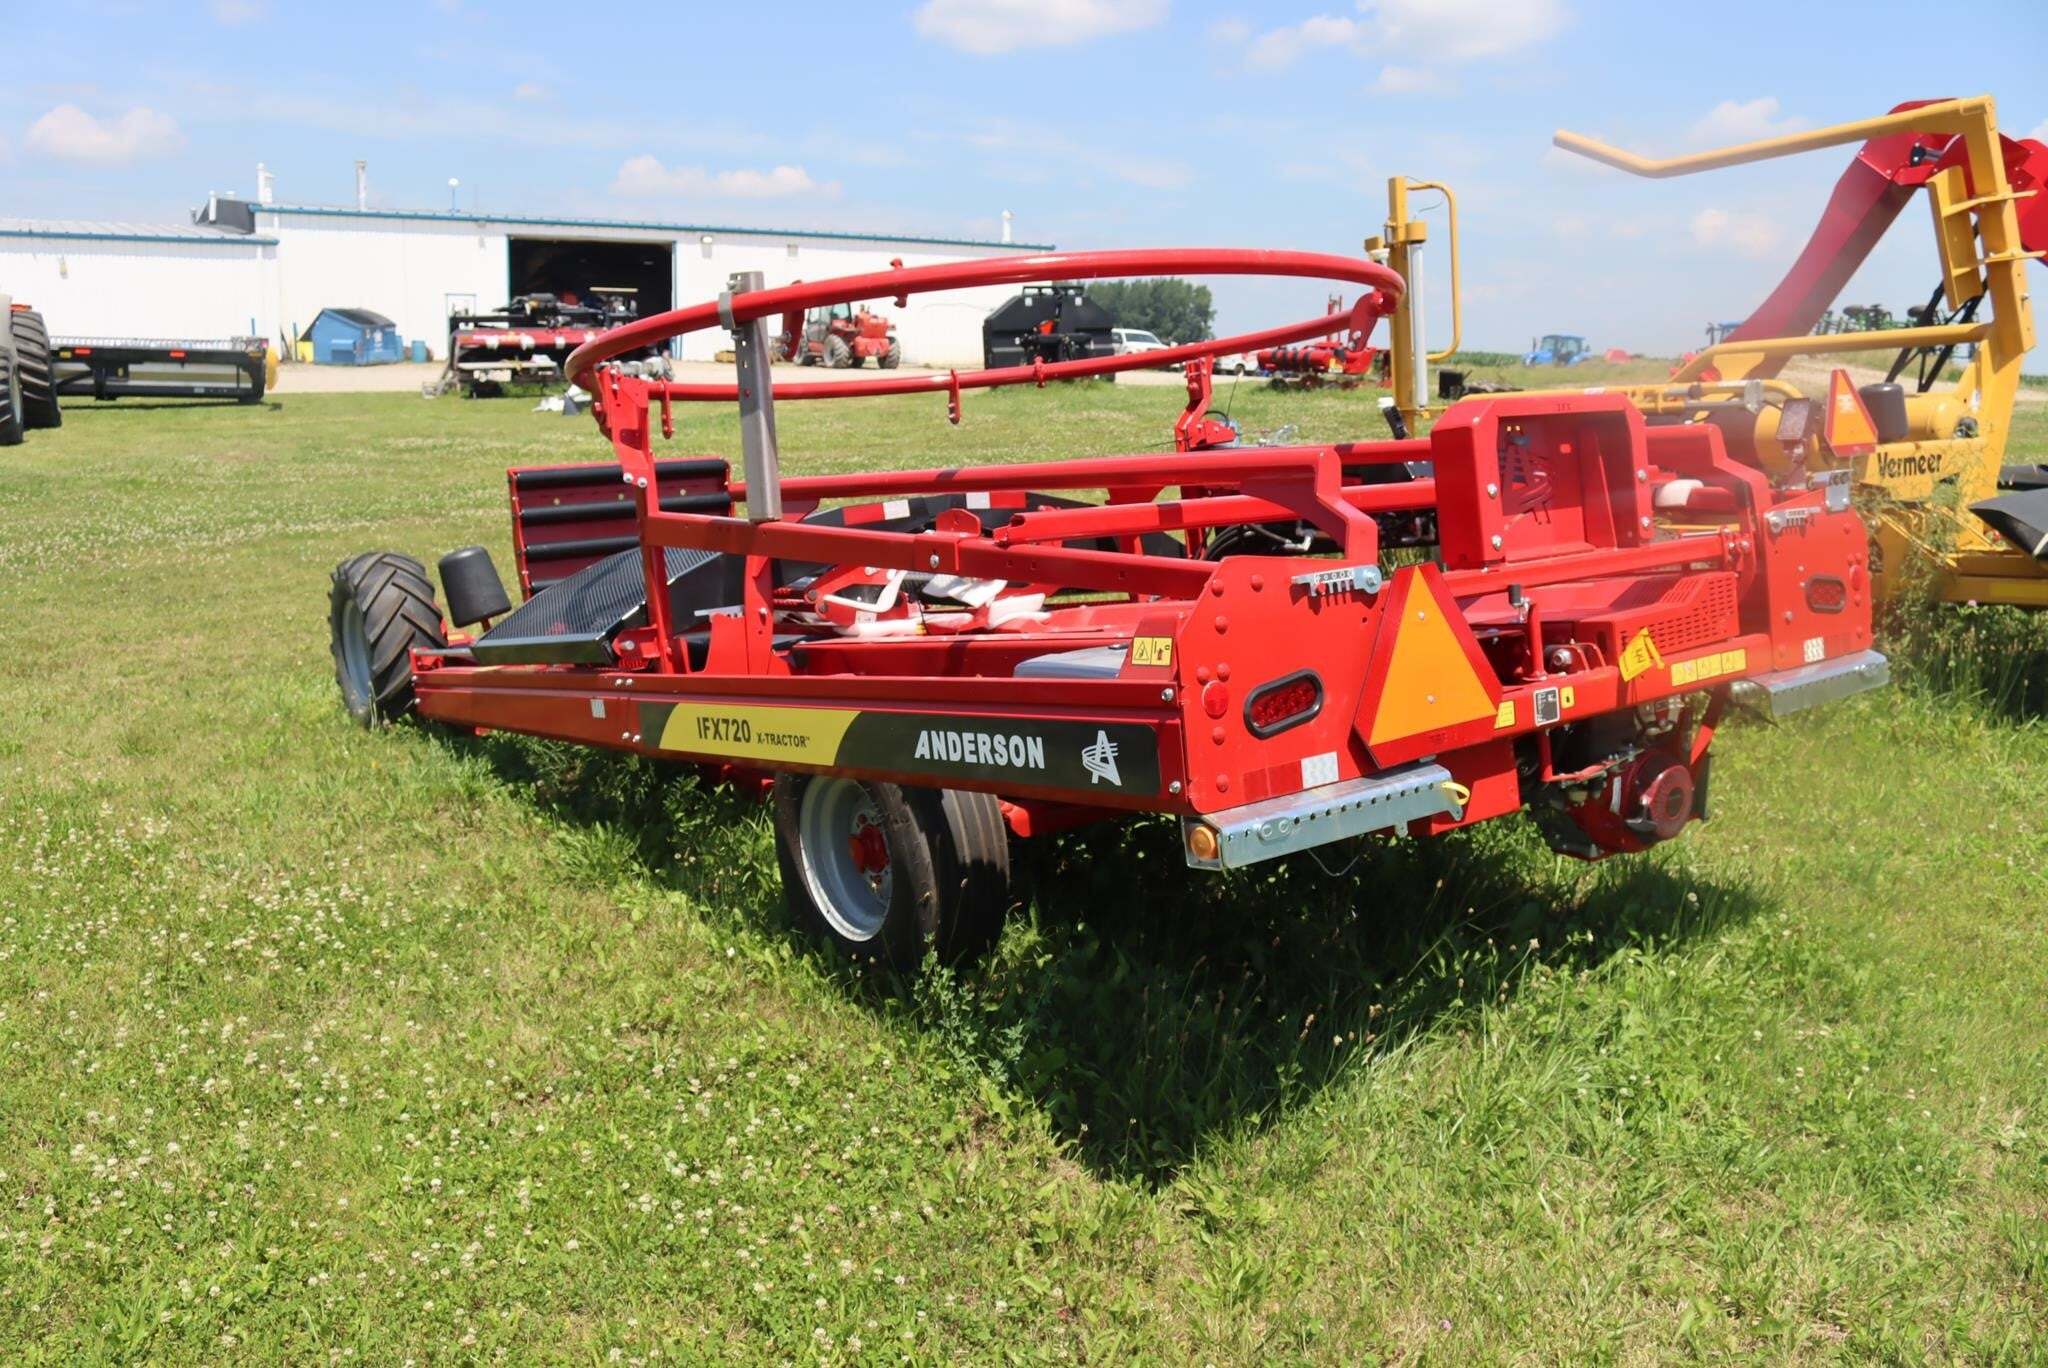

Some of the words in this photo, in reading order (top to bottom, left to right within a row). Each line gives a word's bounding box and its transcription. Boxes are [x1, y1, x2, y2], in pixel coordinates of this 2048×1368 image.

[1877, 451, 1942, 478] Vermeer
[696, 716, 752, 743] IFX720
[914, 730, 1045, 769] ANDERSON
